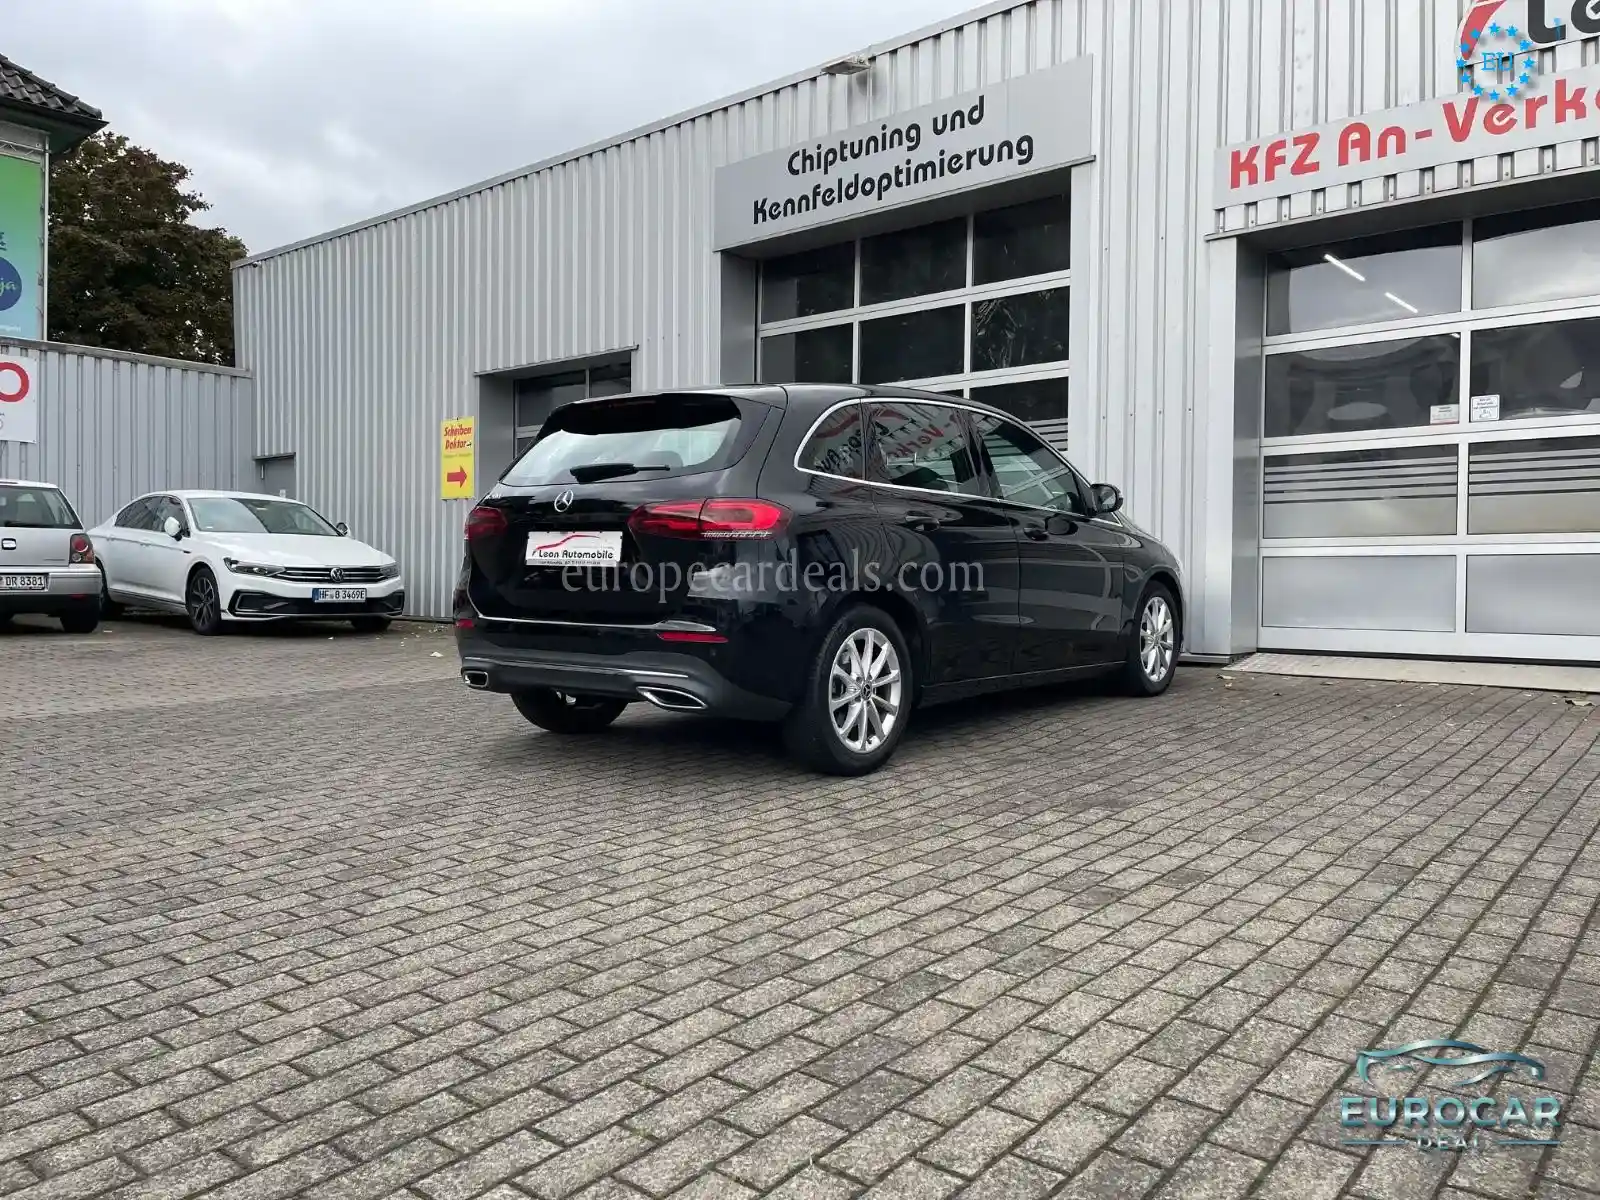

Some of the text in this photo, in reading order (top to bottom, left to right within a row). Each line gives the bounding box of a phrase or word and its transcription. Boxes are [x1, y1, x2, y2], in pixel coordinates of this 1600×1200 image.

[786, 95, 985, 176] Chiptuning und
[1337, 78, 1600, 168] An-Verk
[752, 134, 1034, 225] Kennfeldoptimierung
[19, 576, 43, 586] 8381
[539, 550, 614, 559] Leon Automobile
